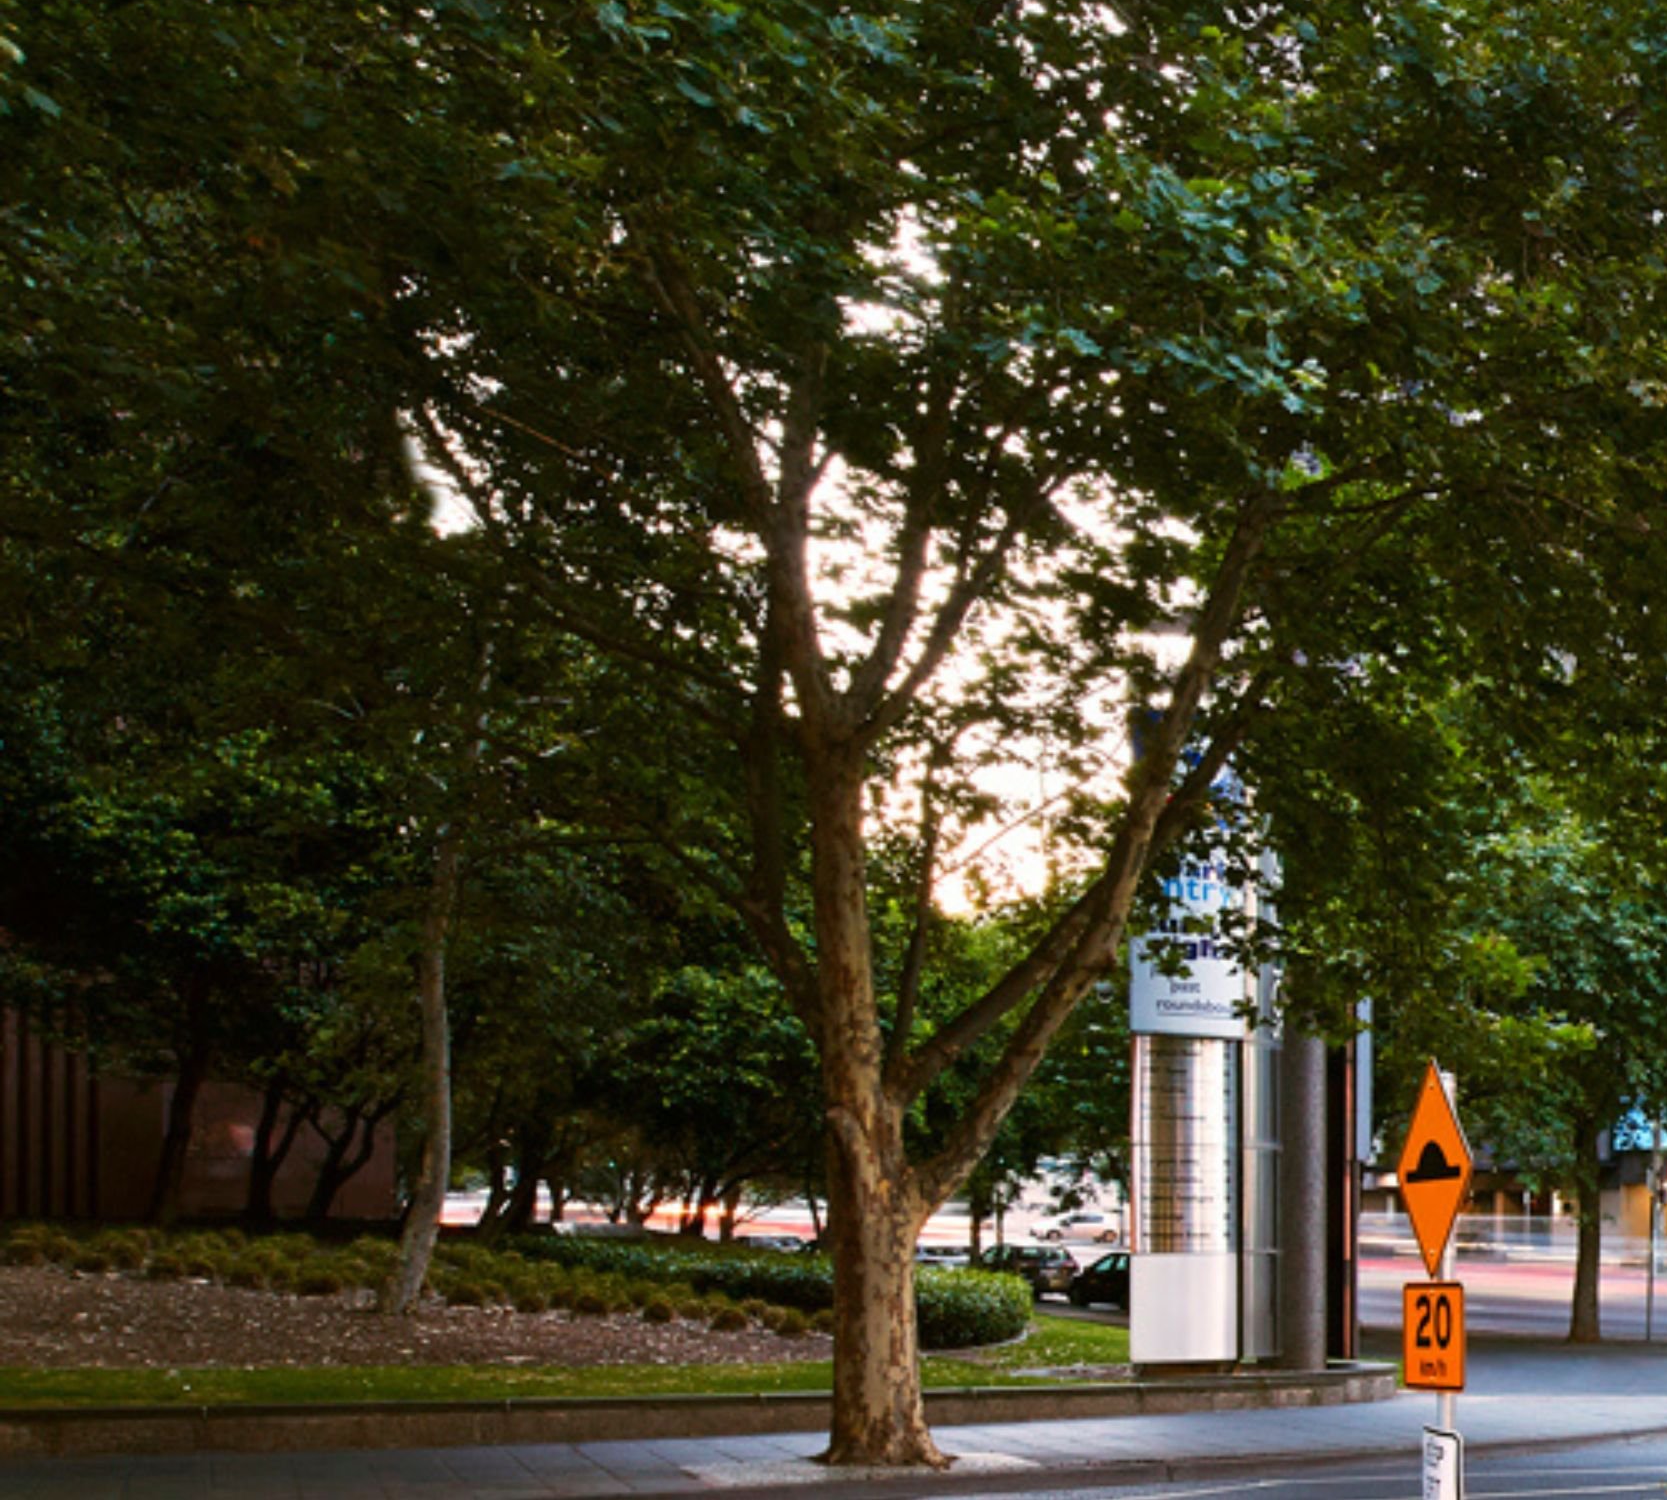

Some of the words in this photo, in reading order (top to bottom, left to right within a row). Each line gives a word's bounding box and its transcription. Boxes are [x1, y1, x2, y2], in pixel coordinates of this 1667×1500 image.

[1162, 878, 1234, 908] ntry
[1415, 1294, 1452, 1349] 20
[1419, 1359, 1448, 1378] km/h
